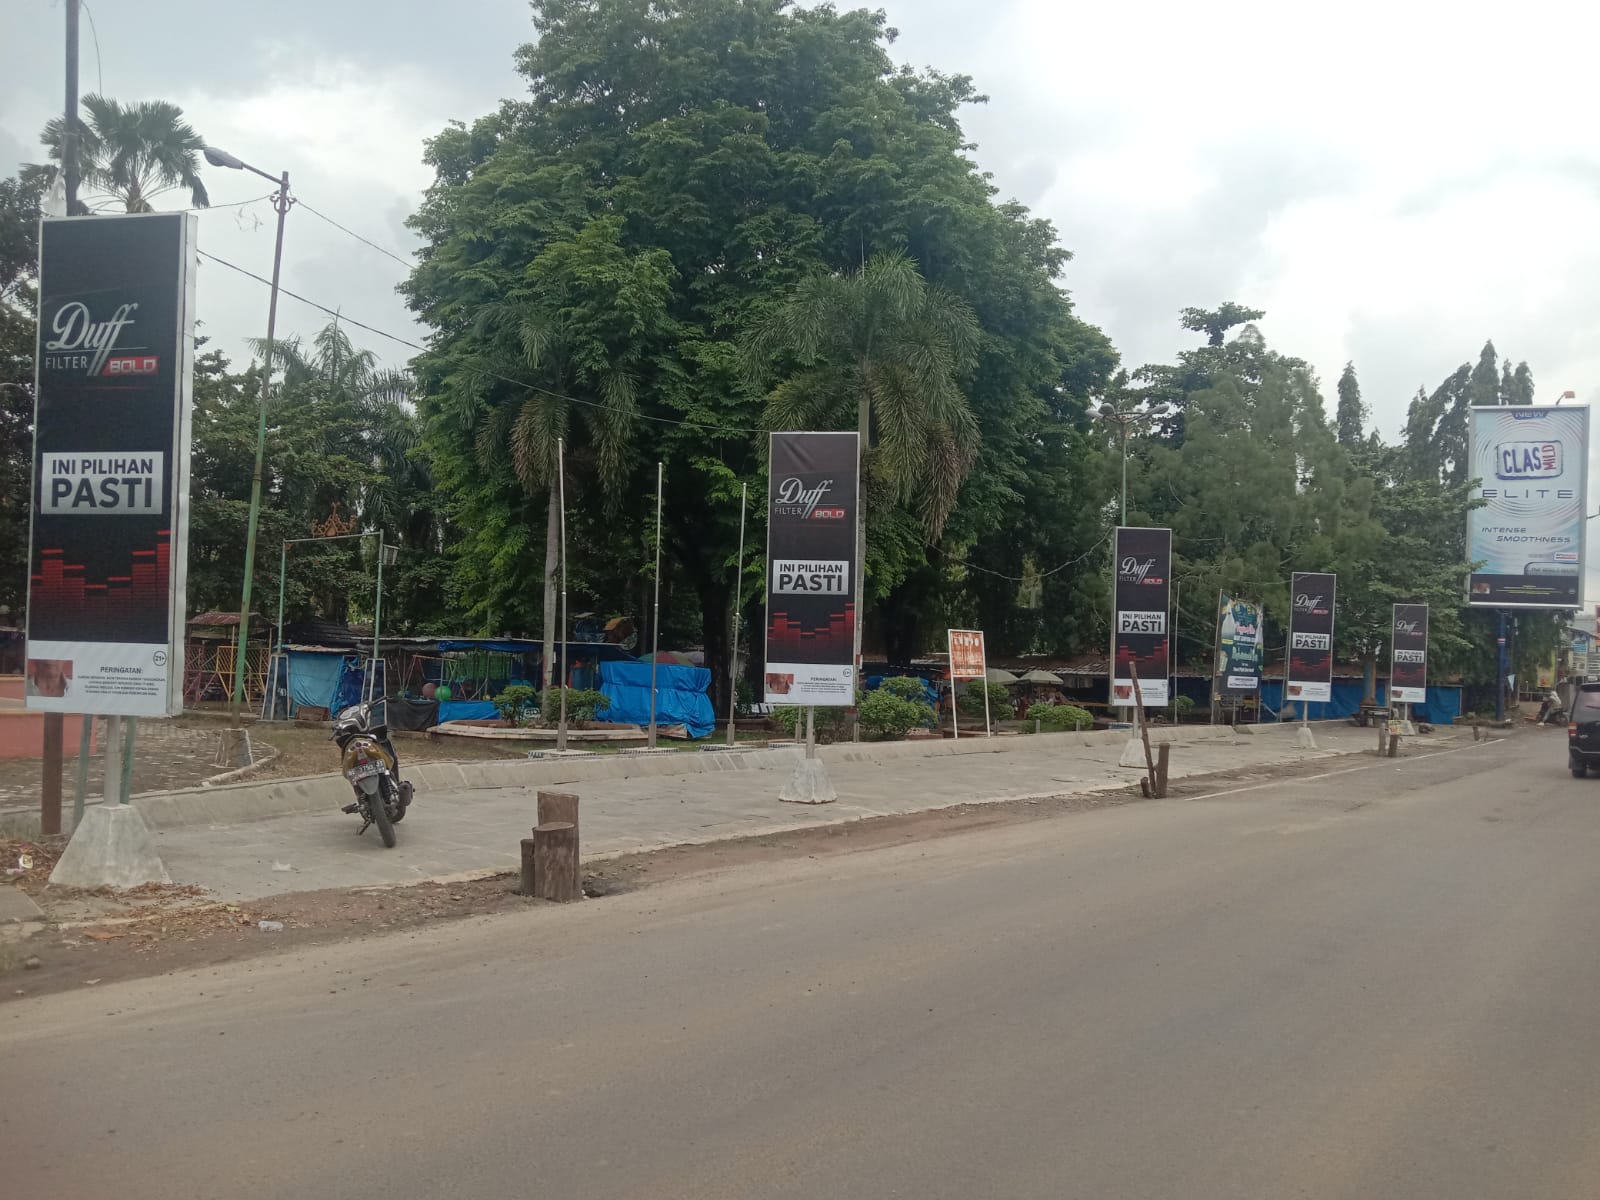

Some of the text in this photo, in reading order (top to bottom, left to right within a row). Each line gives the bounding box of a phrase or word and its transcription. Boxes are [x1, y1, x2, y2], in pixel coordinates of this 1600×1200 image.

[46, 302, 138, 376] Duff
[45, 356, 155, 373] FILTER BOLD
[1503, 447, 1542, 474] CLAS
[1542, 445, 1556, 470] MILD
[53, 459, 152, 475] INI PILIHAN
[51, 478, 152, 508] PASTI
[775, 477, 833, 519] Duff
[1482, 489, 1573, 498] ELITE
[815, 510, 845, 518] BOLD
[780, 564, 842, 573] INI PILIHAN
[1120, 556, 1156, 584] Duff
[779, 574, 842, 591] PASTI
[1294, 594, 1323, 614] Duff
[1122, 621, 1161, 632] PASTI
[1296, 639, 1326, 648] PASTI
[1398, 654, 1422, 662] PASTI
[100, 666, 144, 674] PERINGATAN:
